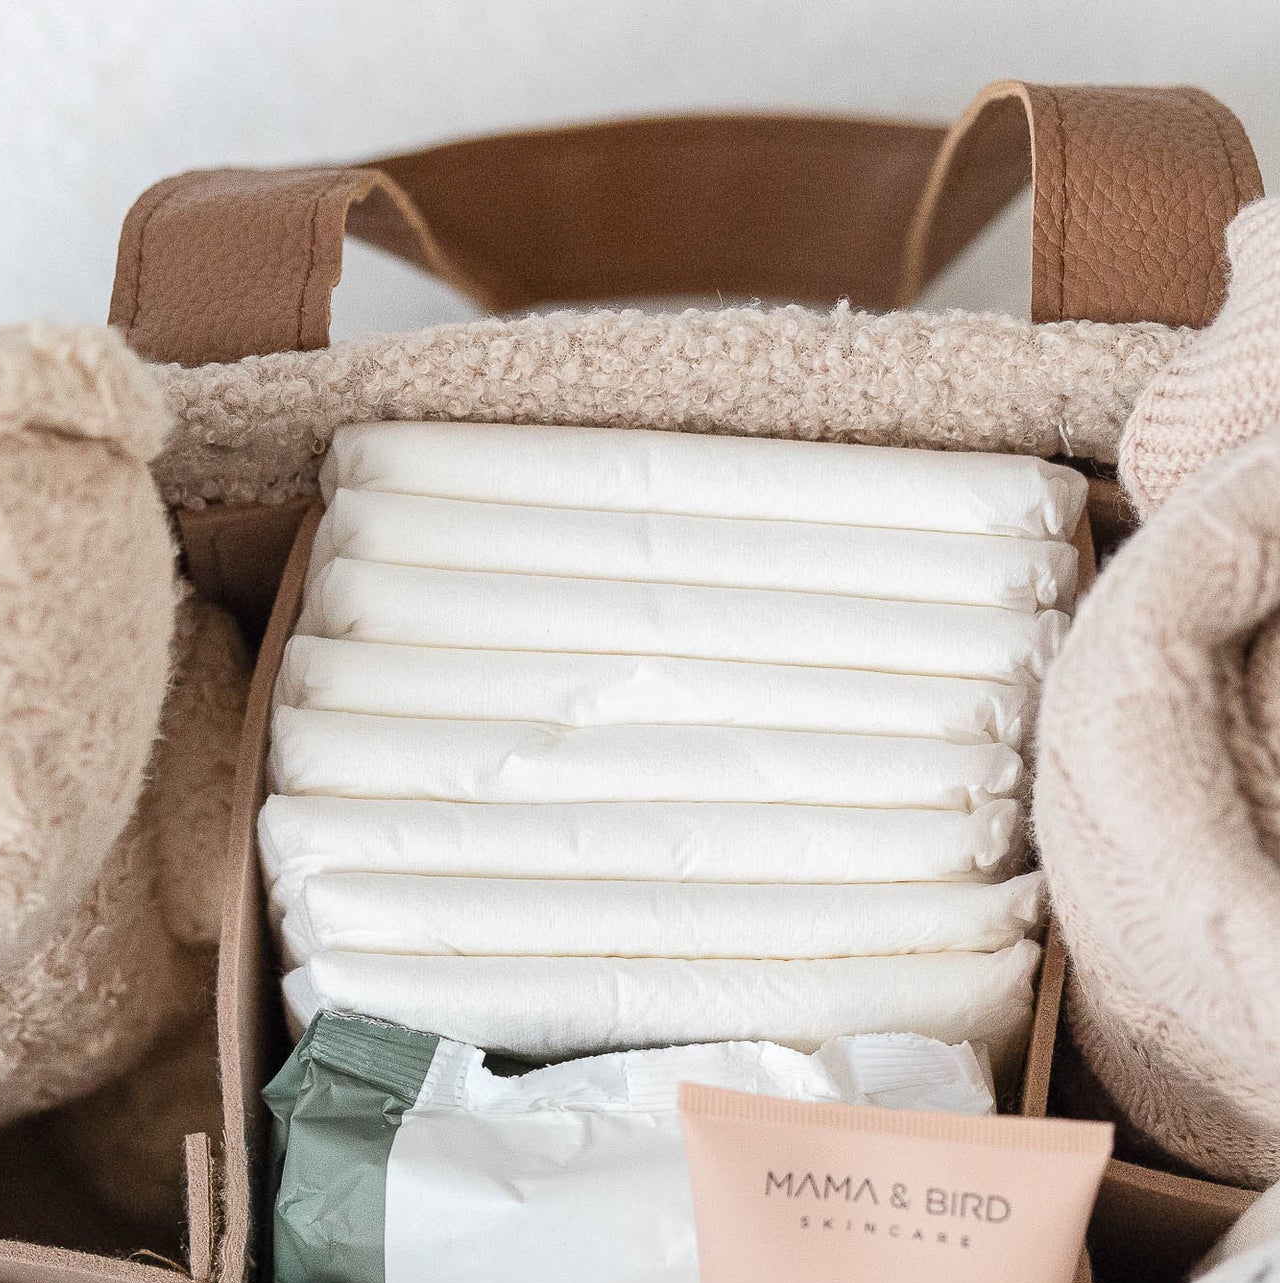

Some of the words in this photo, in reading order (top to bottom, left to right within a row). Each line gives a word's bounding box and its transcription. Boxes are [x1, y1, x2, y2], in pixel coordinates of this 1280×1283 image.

[765, 1171, 880, 1204] MAMA
[889, 1182, 910, 1210] &
[925, 1187, 1012, 1224] BIRD
[800, 1214, 971, 1249] SKINCARE
